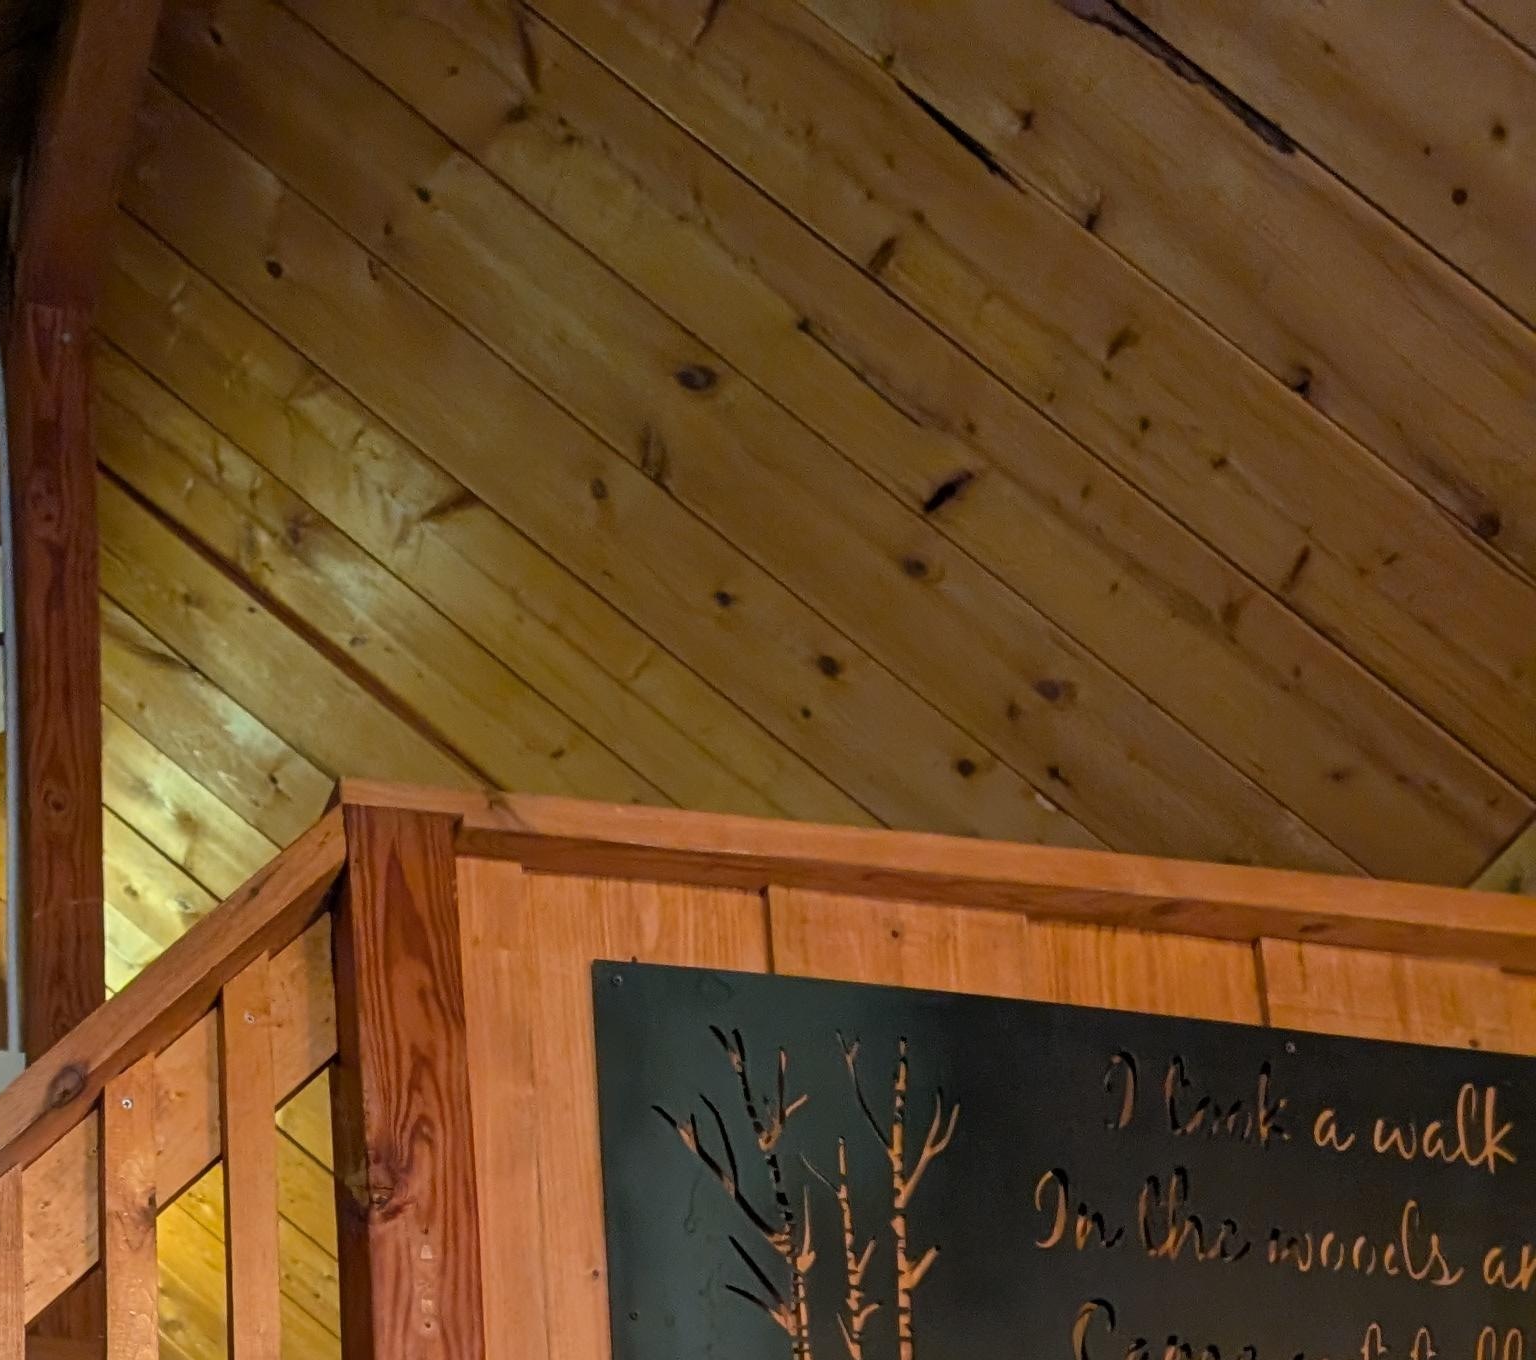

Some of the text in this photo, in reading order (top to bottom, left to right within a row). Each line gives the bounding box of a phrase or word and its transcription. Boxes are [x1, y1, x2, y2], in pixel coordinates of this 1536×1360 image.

[1102, 1050, 1137, 1130] I
[1314, 1107, 1356, 1152] a
[1373, 1083, 1518, 1174] walk
[1035, 1166, 1125, 1250] In
[1137, 1165, 1251, 1263] the
[1267, 1199, 1464, 1286] woods
